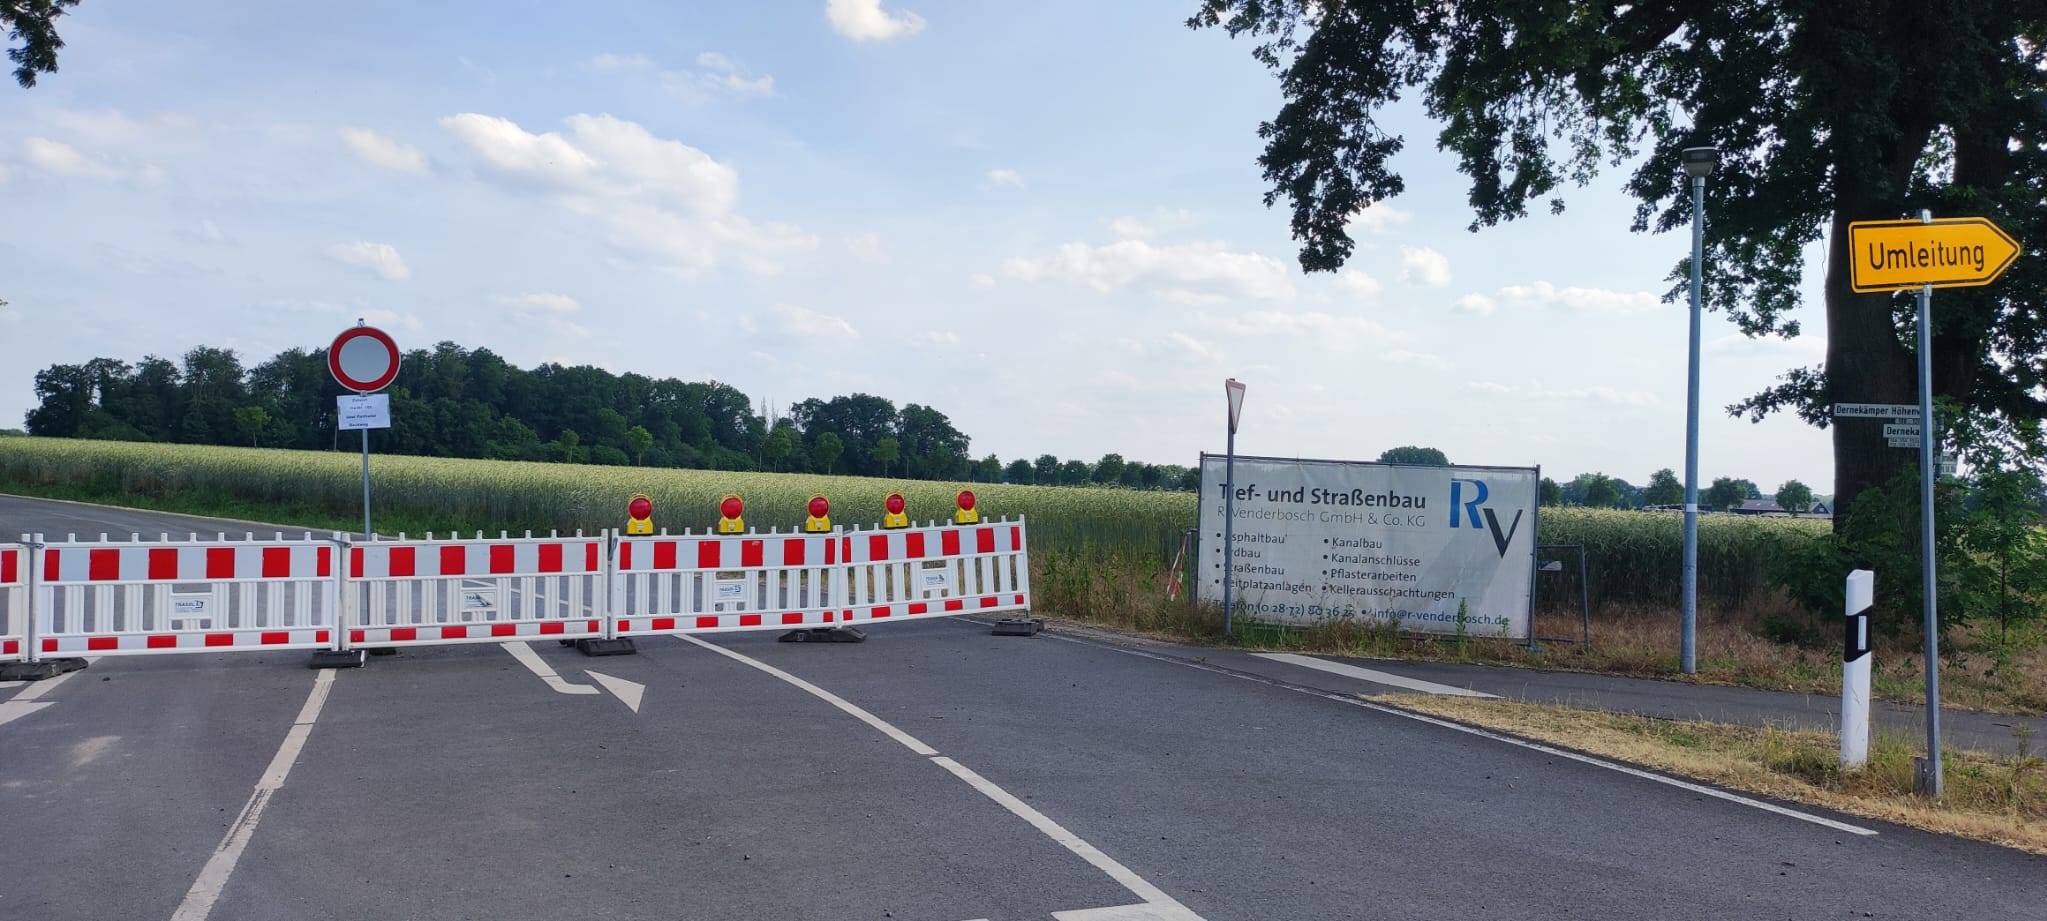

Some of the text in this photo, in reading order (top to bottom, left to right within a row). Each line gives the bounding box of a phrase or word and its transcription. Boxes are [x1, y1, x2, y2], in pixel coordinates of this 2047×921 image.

[1869, 240, 1985, 272] Umleitung
[1836, 405, 1889, 417] Dernekämper
[1219, 483, 1426, 509] Tef- und Straßenbau
[1320, 511, 1363, 524] GmbH
[1367, 512, 1378, 525] &
[1383, 513, 1403, 526] Co.
[1407, 515, 1425, 527] KG
[1225, 532, 1285, 544] sphaltbau
[1332, 537, 1382, 549] Kanalbau
[1331, 553, 1421, 567] Kanalanschlüsse
[1330, 568, 1417, 582] Pflasterarbeiten
[1329, 584, 1455, 601] Kellerausschachtungen
